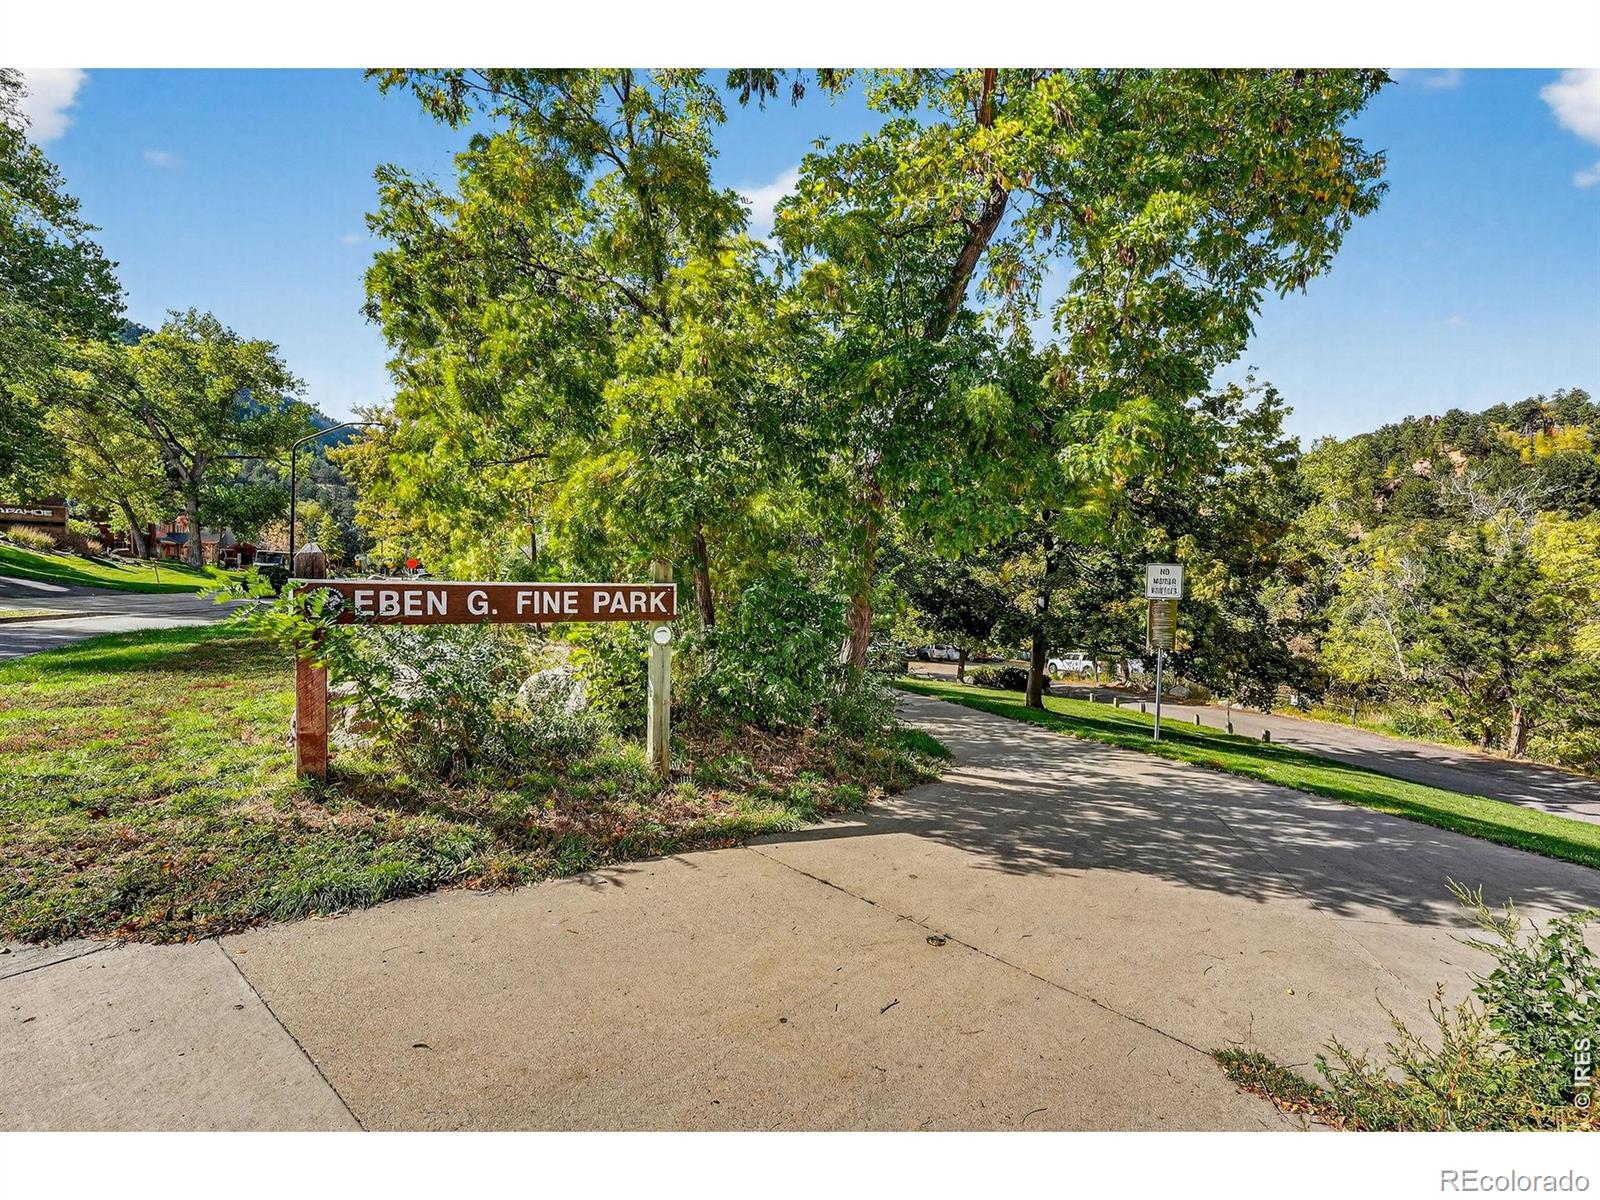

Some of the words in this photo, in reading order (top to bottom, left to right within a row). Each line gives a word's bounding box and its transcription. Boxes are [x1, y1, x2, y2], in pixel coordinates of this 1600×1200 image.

[354, 589, 448, 616] EBEN
[467, 590, 498, 616] G.
[516, 591, 579, 615] FINE
[593, 591, 668, 614] PARK
